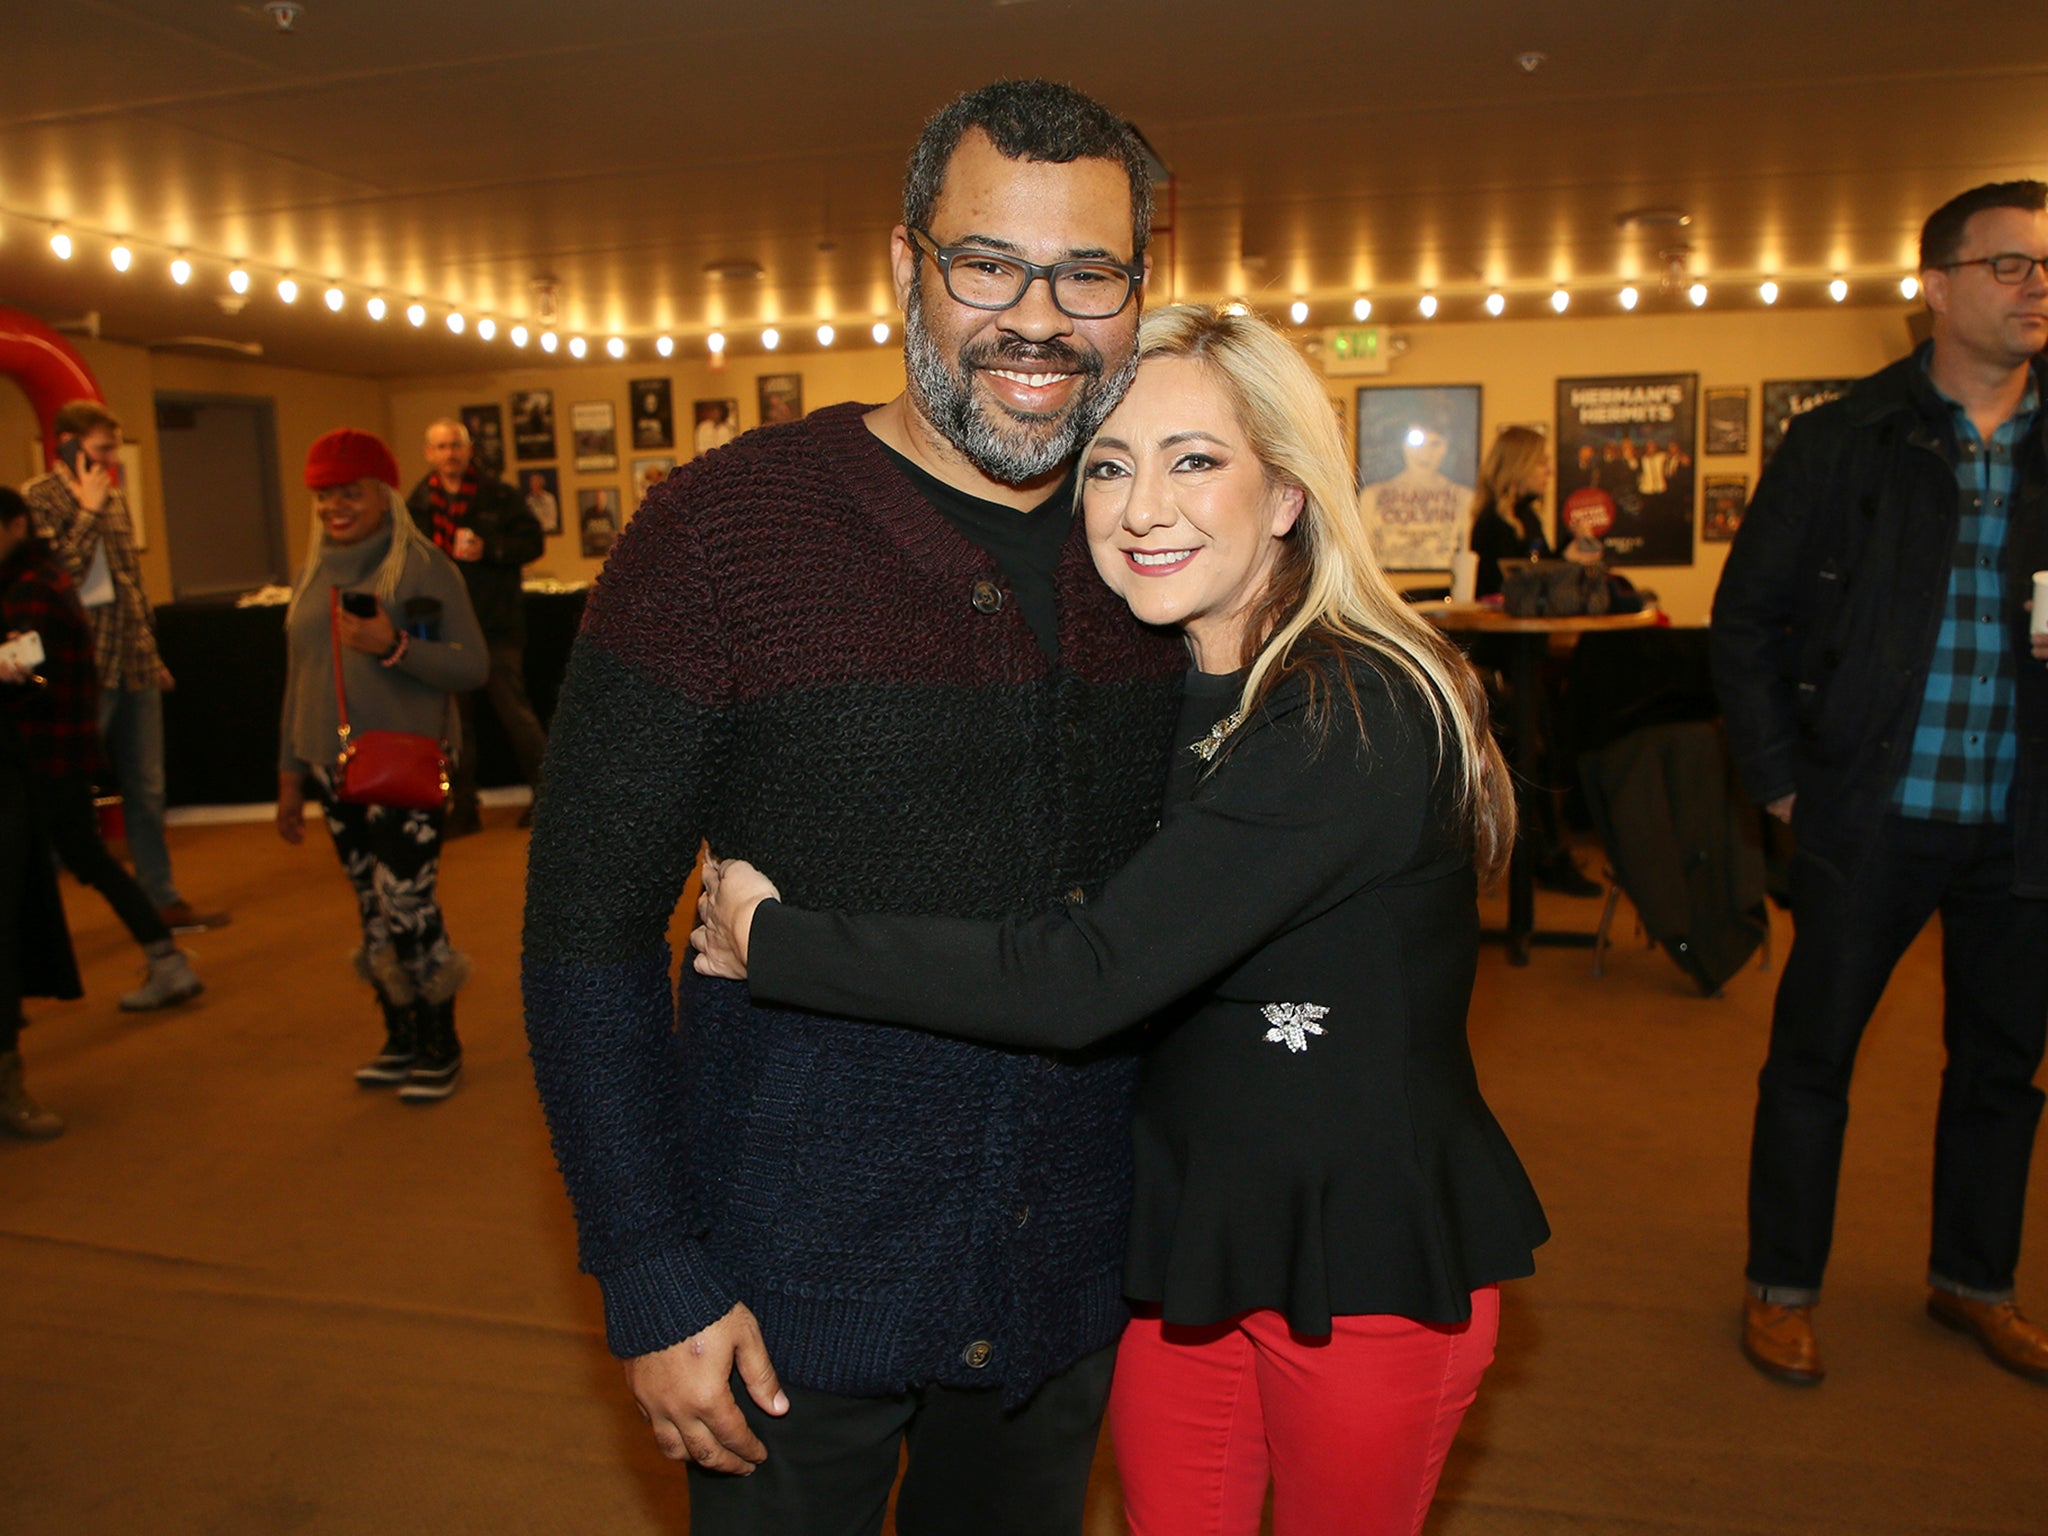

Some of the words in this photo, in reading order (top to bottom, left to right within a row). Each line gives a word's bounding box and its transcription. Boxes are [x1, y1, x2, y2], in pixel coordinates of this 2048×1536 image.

[1336, 329, 1377, 360] EXIT
[1571, 385, 1682, 408] HERMAN'S
[1580, 403, 1674, 424] HERMITS
